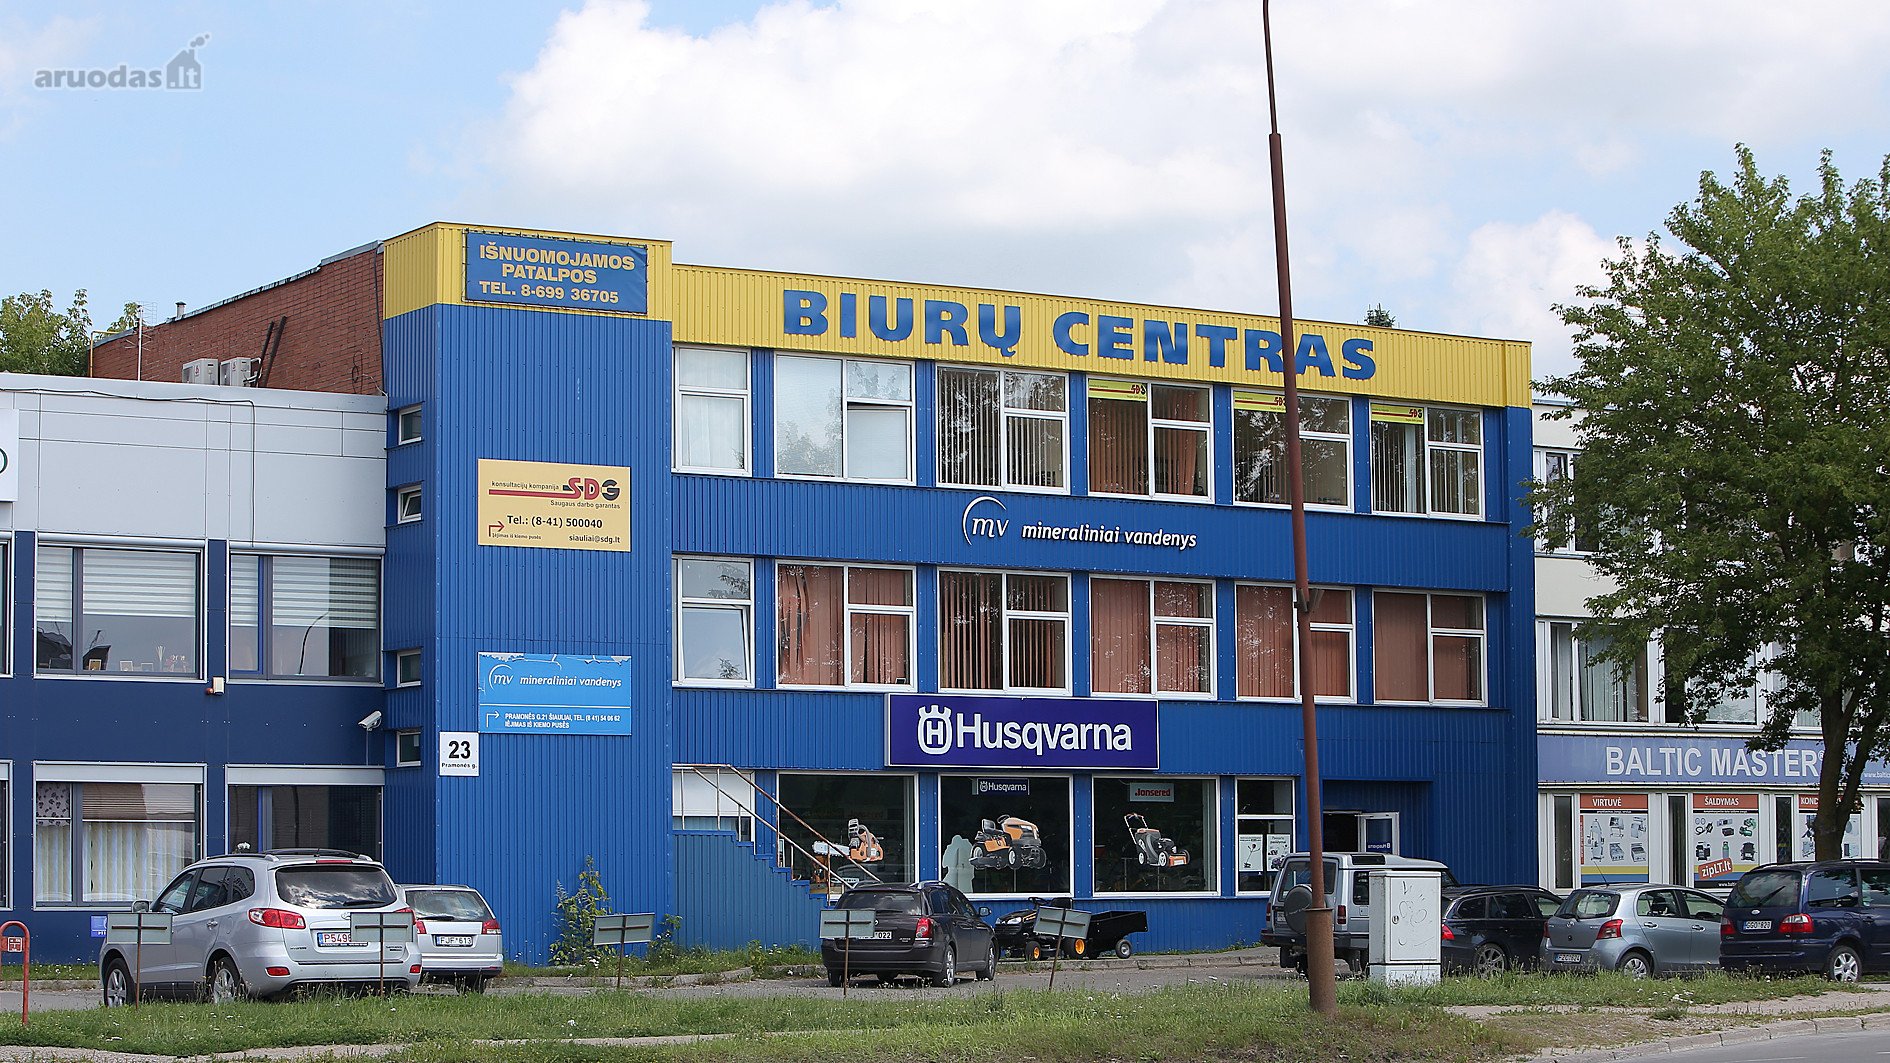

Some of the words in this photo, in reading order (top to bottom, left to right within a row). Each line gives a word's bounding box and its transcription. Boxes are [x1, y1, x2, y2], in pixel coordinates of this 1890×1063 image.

[480, 241, 635, 271] IŠNUOMOJAMOS
[502, 263, 598, 284] PATALPOS
[479, 281, 516, 296] TEL.
[521, 284, 565, 300] 8-699
[570, 288, 619, 303] 36705
[783, 289, 1021, 357] BIURŲ
[1052, 311, 1376, 380] CENTRAS
[491, 480, 528, 490] konsultacijų
[568, 477, 621, 501] SDG
[550, 499, 576, 508] Saugaus
[576, 500, 594, 508] darbo
[595, 502, 621, 510] garantas
[506, 515, 529, 525] Tel.:
[531, 515, 563, 528] (8-41)
[565, 518, 603, 528] 500040
[569, 534, 621, 544] siauliai@sdg.lt
[1022, 521, 1120, 543] mineraliniai
[1124, 528, 1197, 550] vandenys
[520, 674, 577, 686] mineraliniai
[579, 677, 622, 688] vandenys
[504, 711, 536, 720] PRAMONĖS
[956, 712, 1132, 756] Husqvarna
[448, 740, 471, 759] 23
[1605, 745, 1702, 776] BALTIC
[988, 782, 1027, 793] Husqvarna
[1135, 787, 1171, 797] Jonsered
[1592, 797, 1622, 807] VIRTUVĖ
[1704, 795, 1740, 806] ŠALDYMAS
[1701, 860, 1732, 878] zipLT.lt
